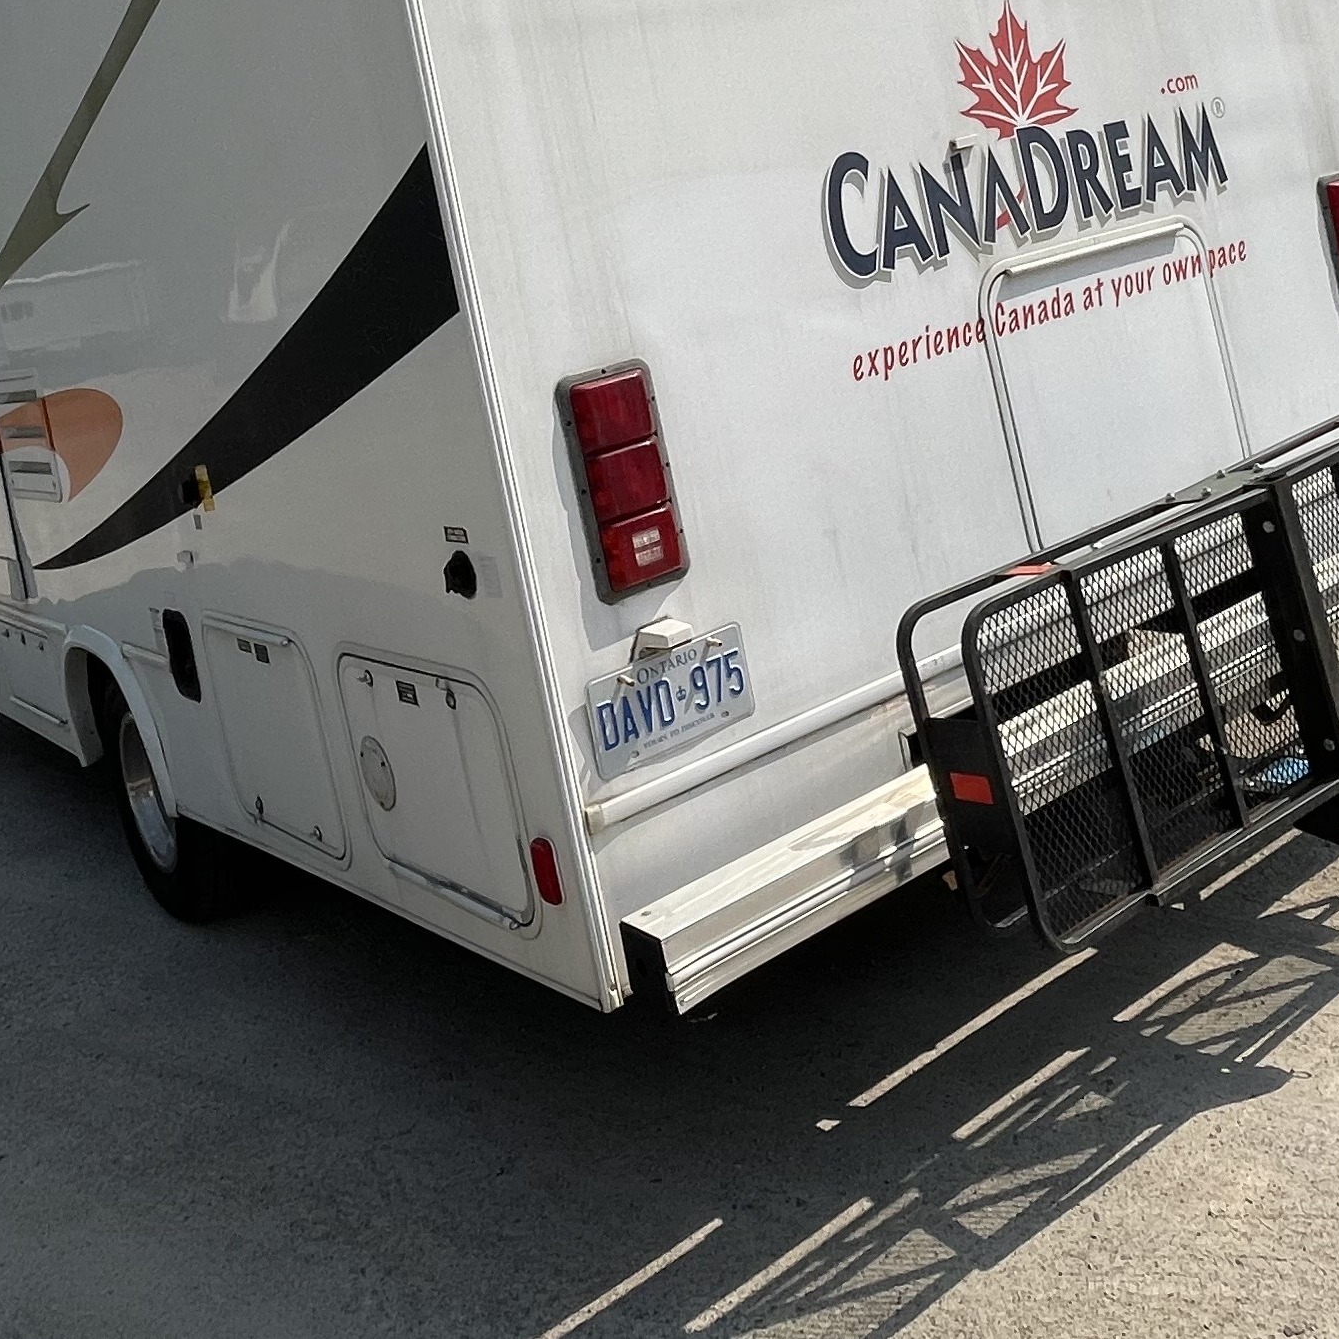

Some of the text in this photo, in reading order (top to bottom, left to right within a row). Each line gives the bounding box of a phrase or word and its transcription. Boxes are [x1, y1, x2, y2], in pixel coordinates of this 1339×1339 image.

[1160, 73, 1199, 95] .com
[852, 239, 1247, 382] experience Canada at your own pace
[636, 648, 698, 685] ONTARIO
